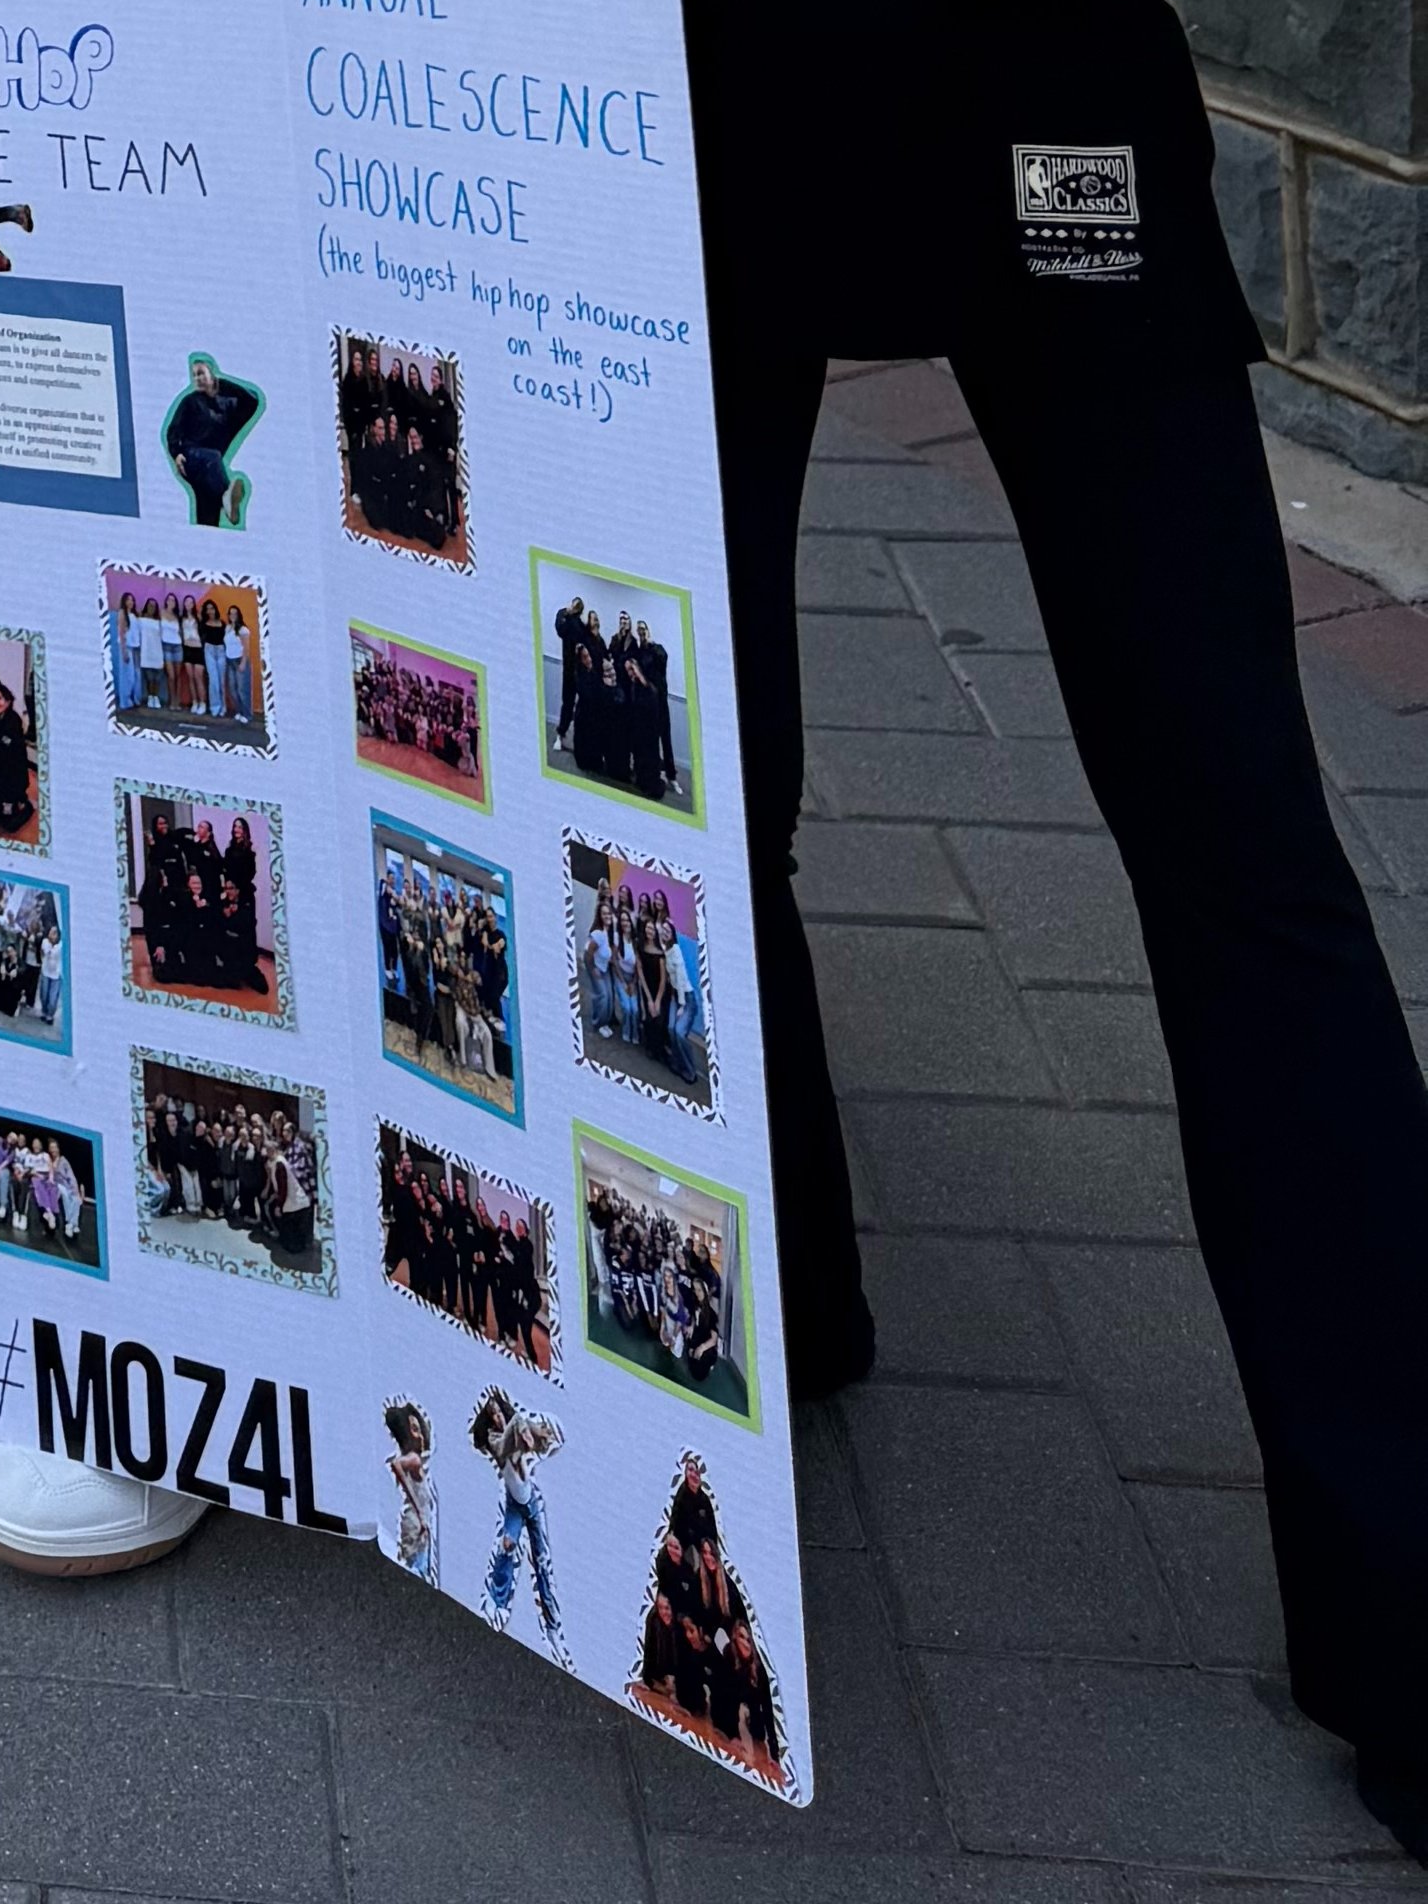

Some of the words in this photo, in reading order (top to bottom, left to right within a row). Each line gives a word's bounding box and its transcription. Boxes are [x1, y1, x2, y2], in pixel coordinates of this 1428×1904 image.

[306, 45, 666, 167] COALESCENCE
[47, 131, 208, 197] TEAM
[314, 148, 530, 244] SHOWCASE
[1051, 157, 1126, 186] HARDWOOD
[317, 223, 364, 277] (the
[375, 240, 458, 301] biggest
[471, 271, 503, 316] hip
[508, 278, 551, 331] hop
[564, 290, 691, 345] showcase
[507, 336, 532, 357] on
[549, 336, 583, 369] the
[600, 355, 652, 387] east
[513, 372, 613, 423] coast!)
